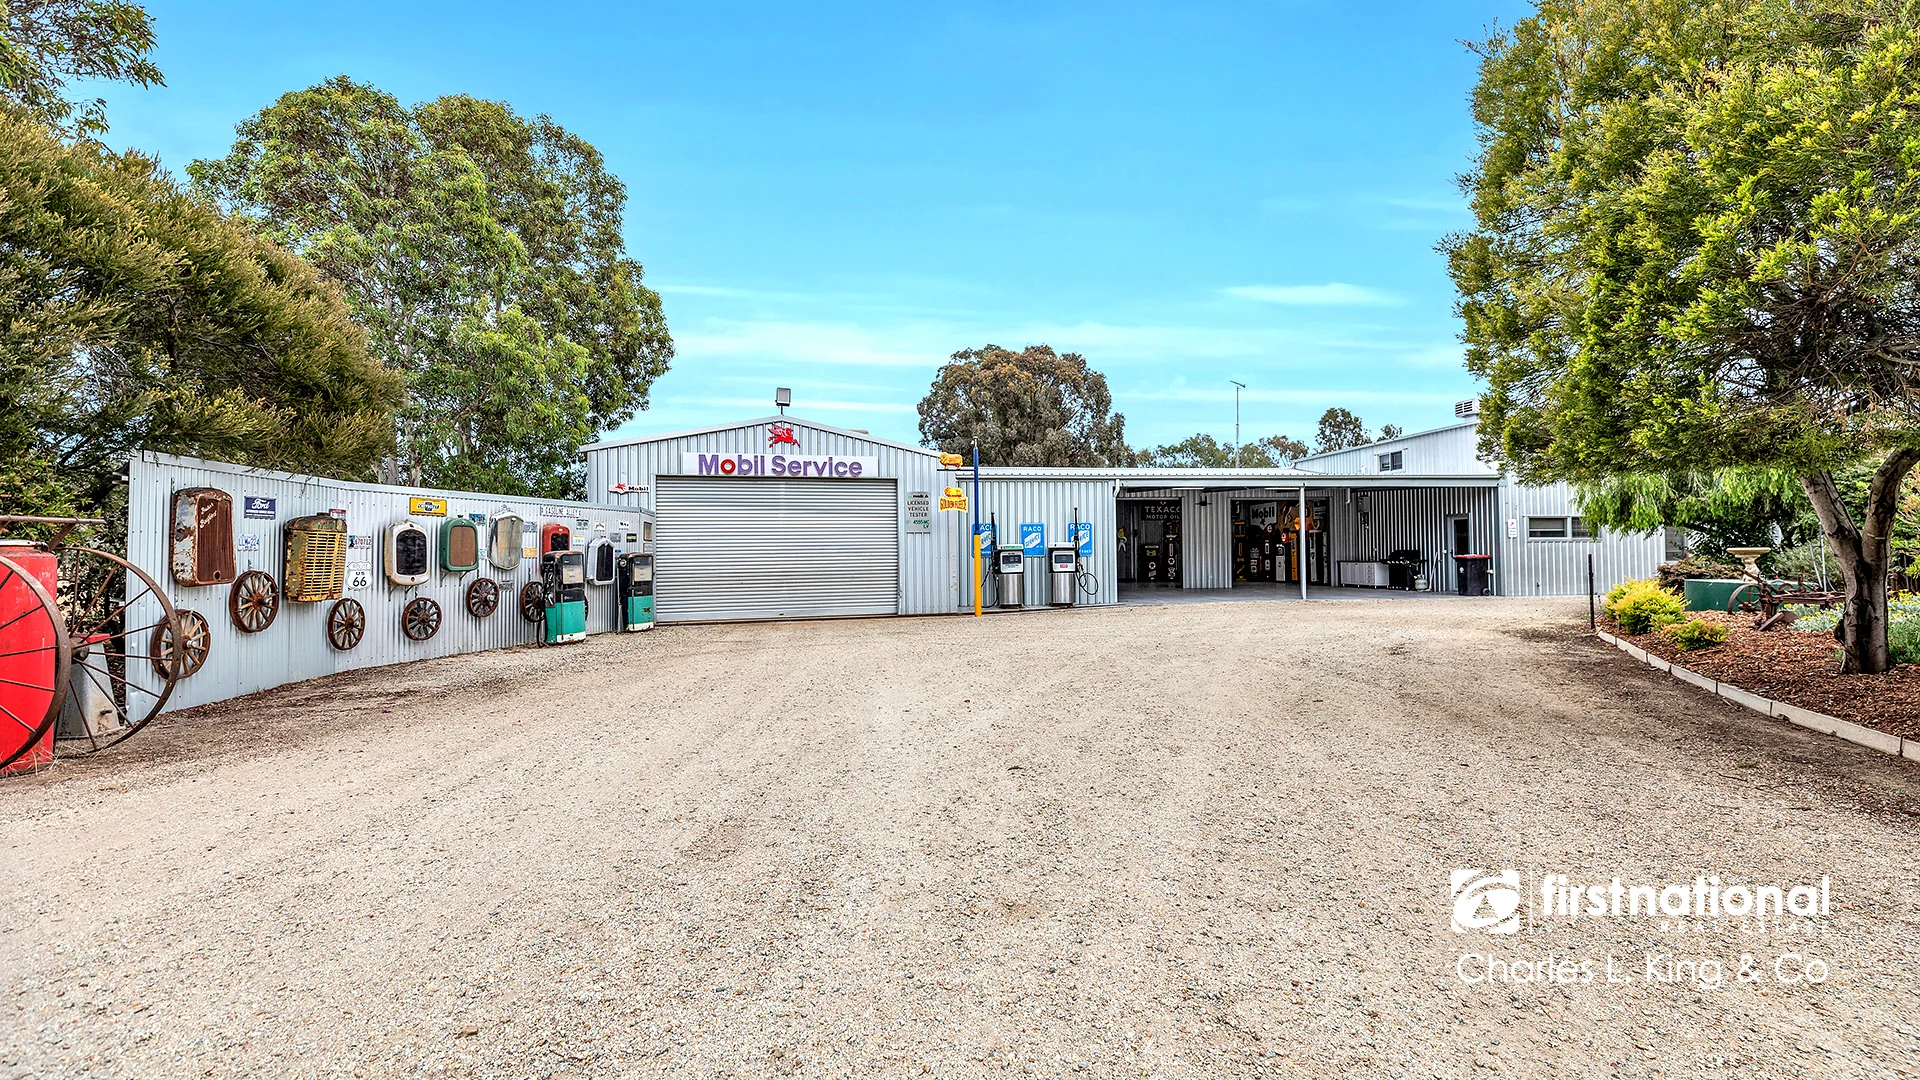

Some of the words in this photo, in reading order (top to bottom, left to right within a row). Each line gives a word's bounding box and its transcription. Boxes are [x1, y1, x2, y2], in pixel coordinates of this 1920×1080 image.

[698, 454, 765, 475] Mobil
[771, 455, 862, 477] Service
[252, 498, 270, 509] Ford
[940, 498, 954, 510] GOLDEN
[1251, 505, 1276, 519] Mobil
[352, 576, 367, 587] 66
